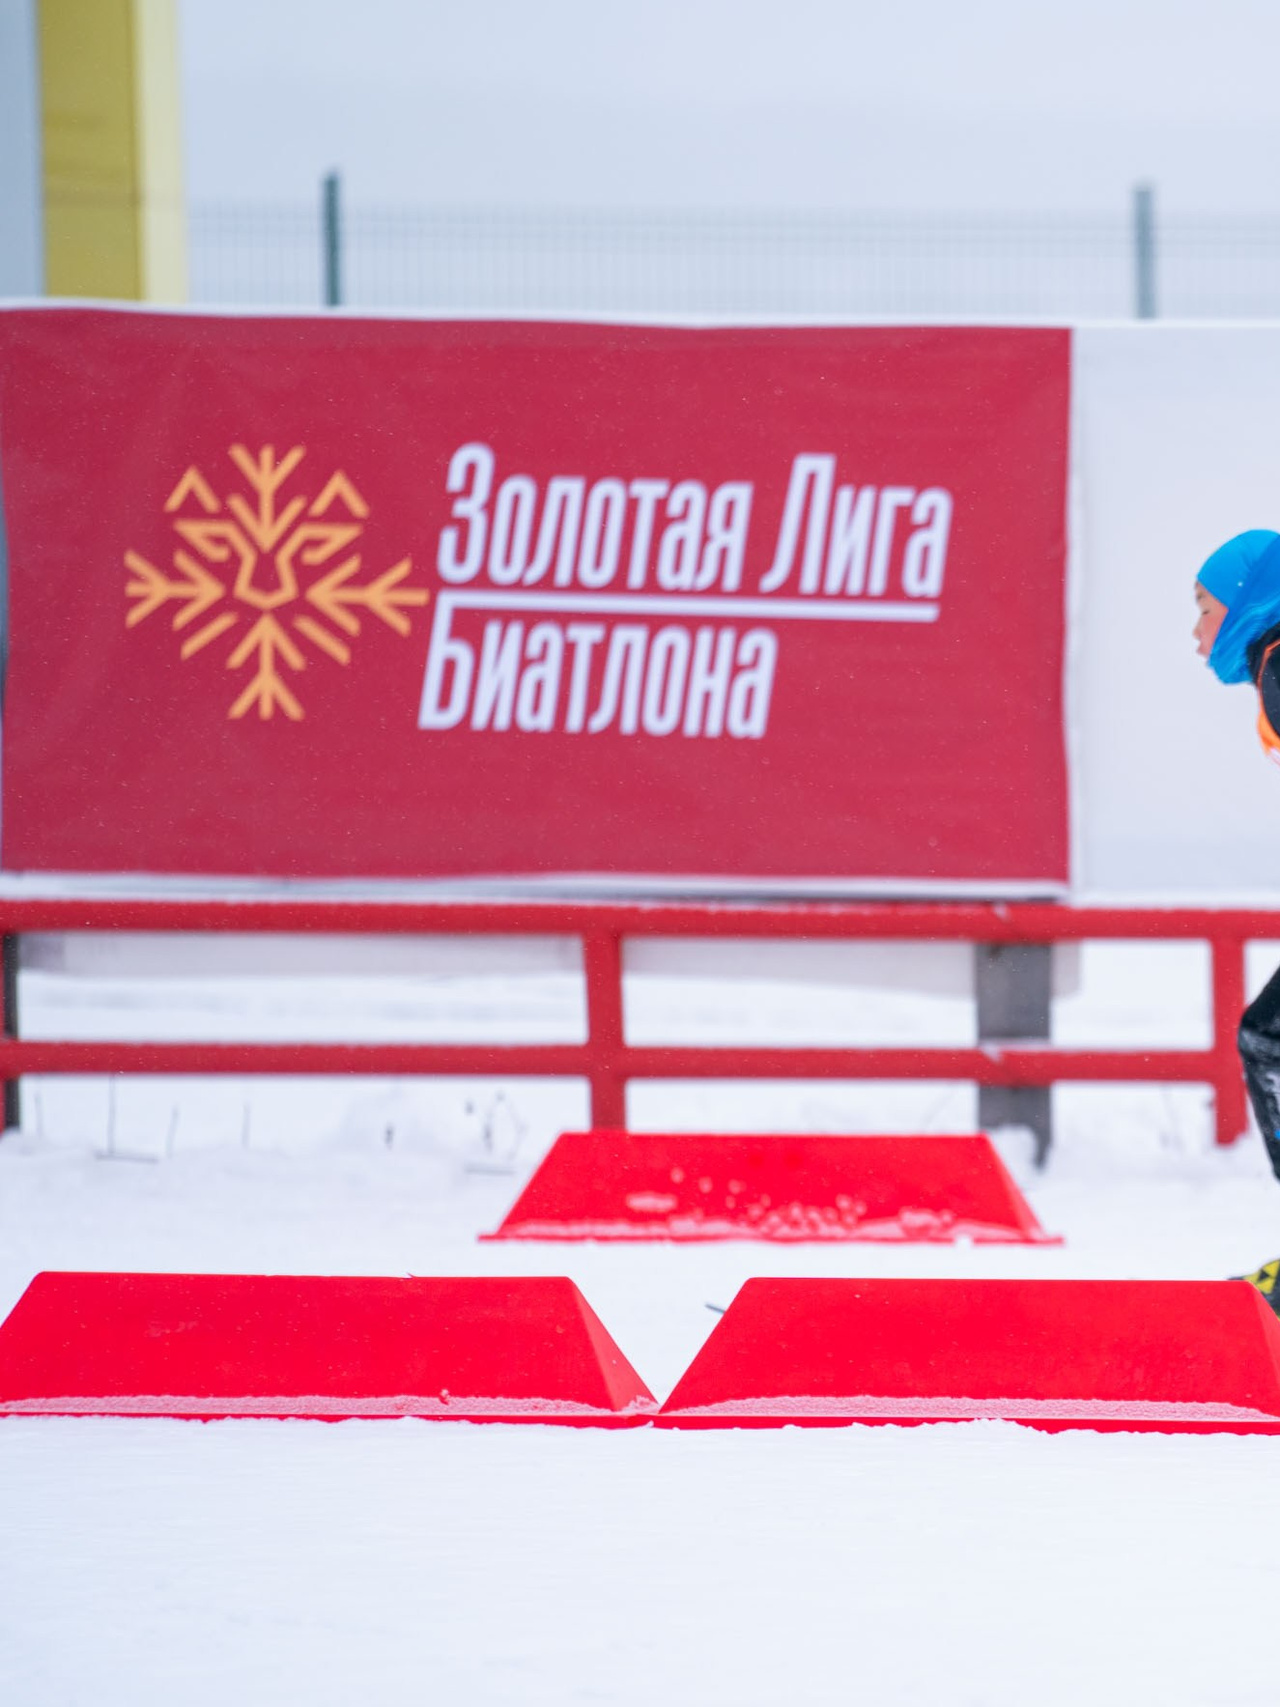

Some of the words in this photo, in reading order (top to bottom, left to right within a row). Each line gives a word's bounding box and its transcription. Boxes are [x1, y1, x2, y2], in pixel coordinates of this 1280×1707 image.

[436, 441, 755, 593] Золотая
[758, 452, 954, 599] Лига
[417, 588, 779, 739] Биатлона
